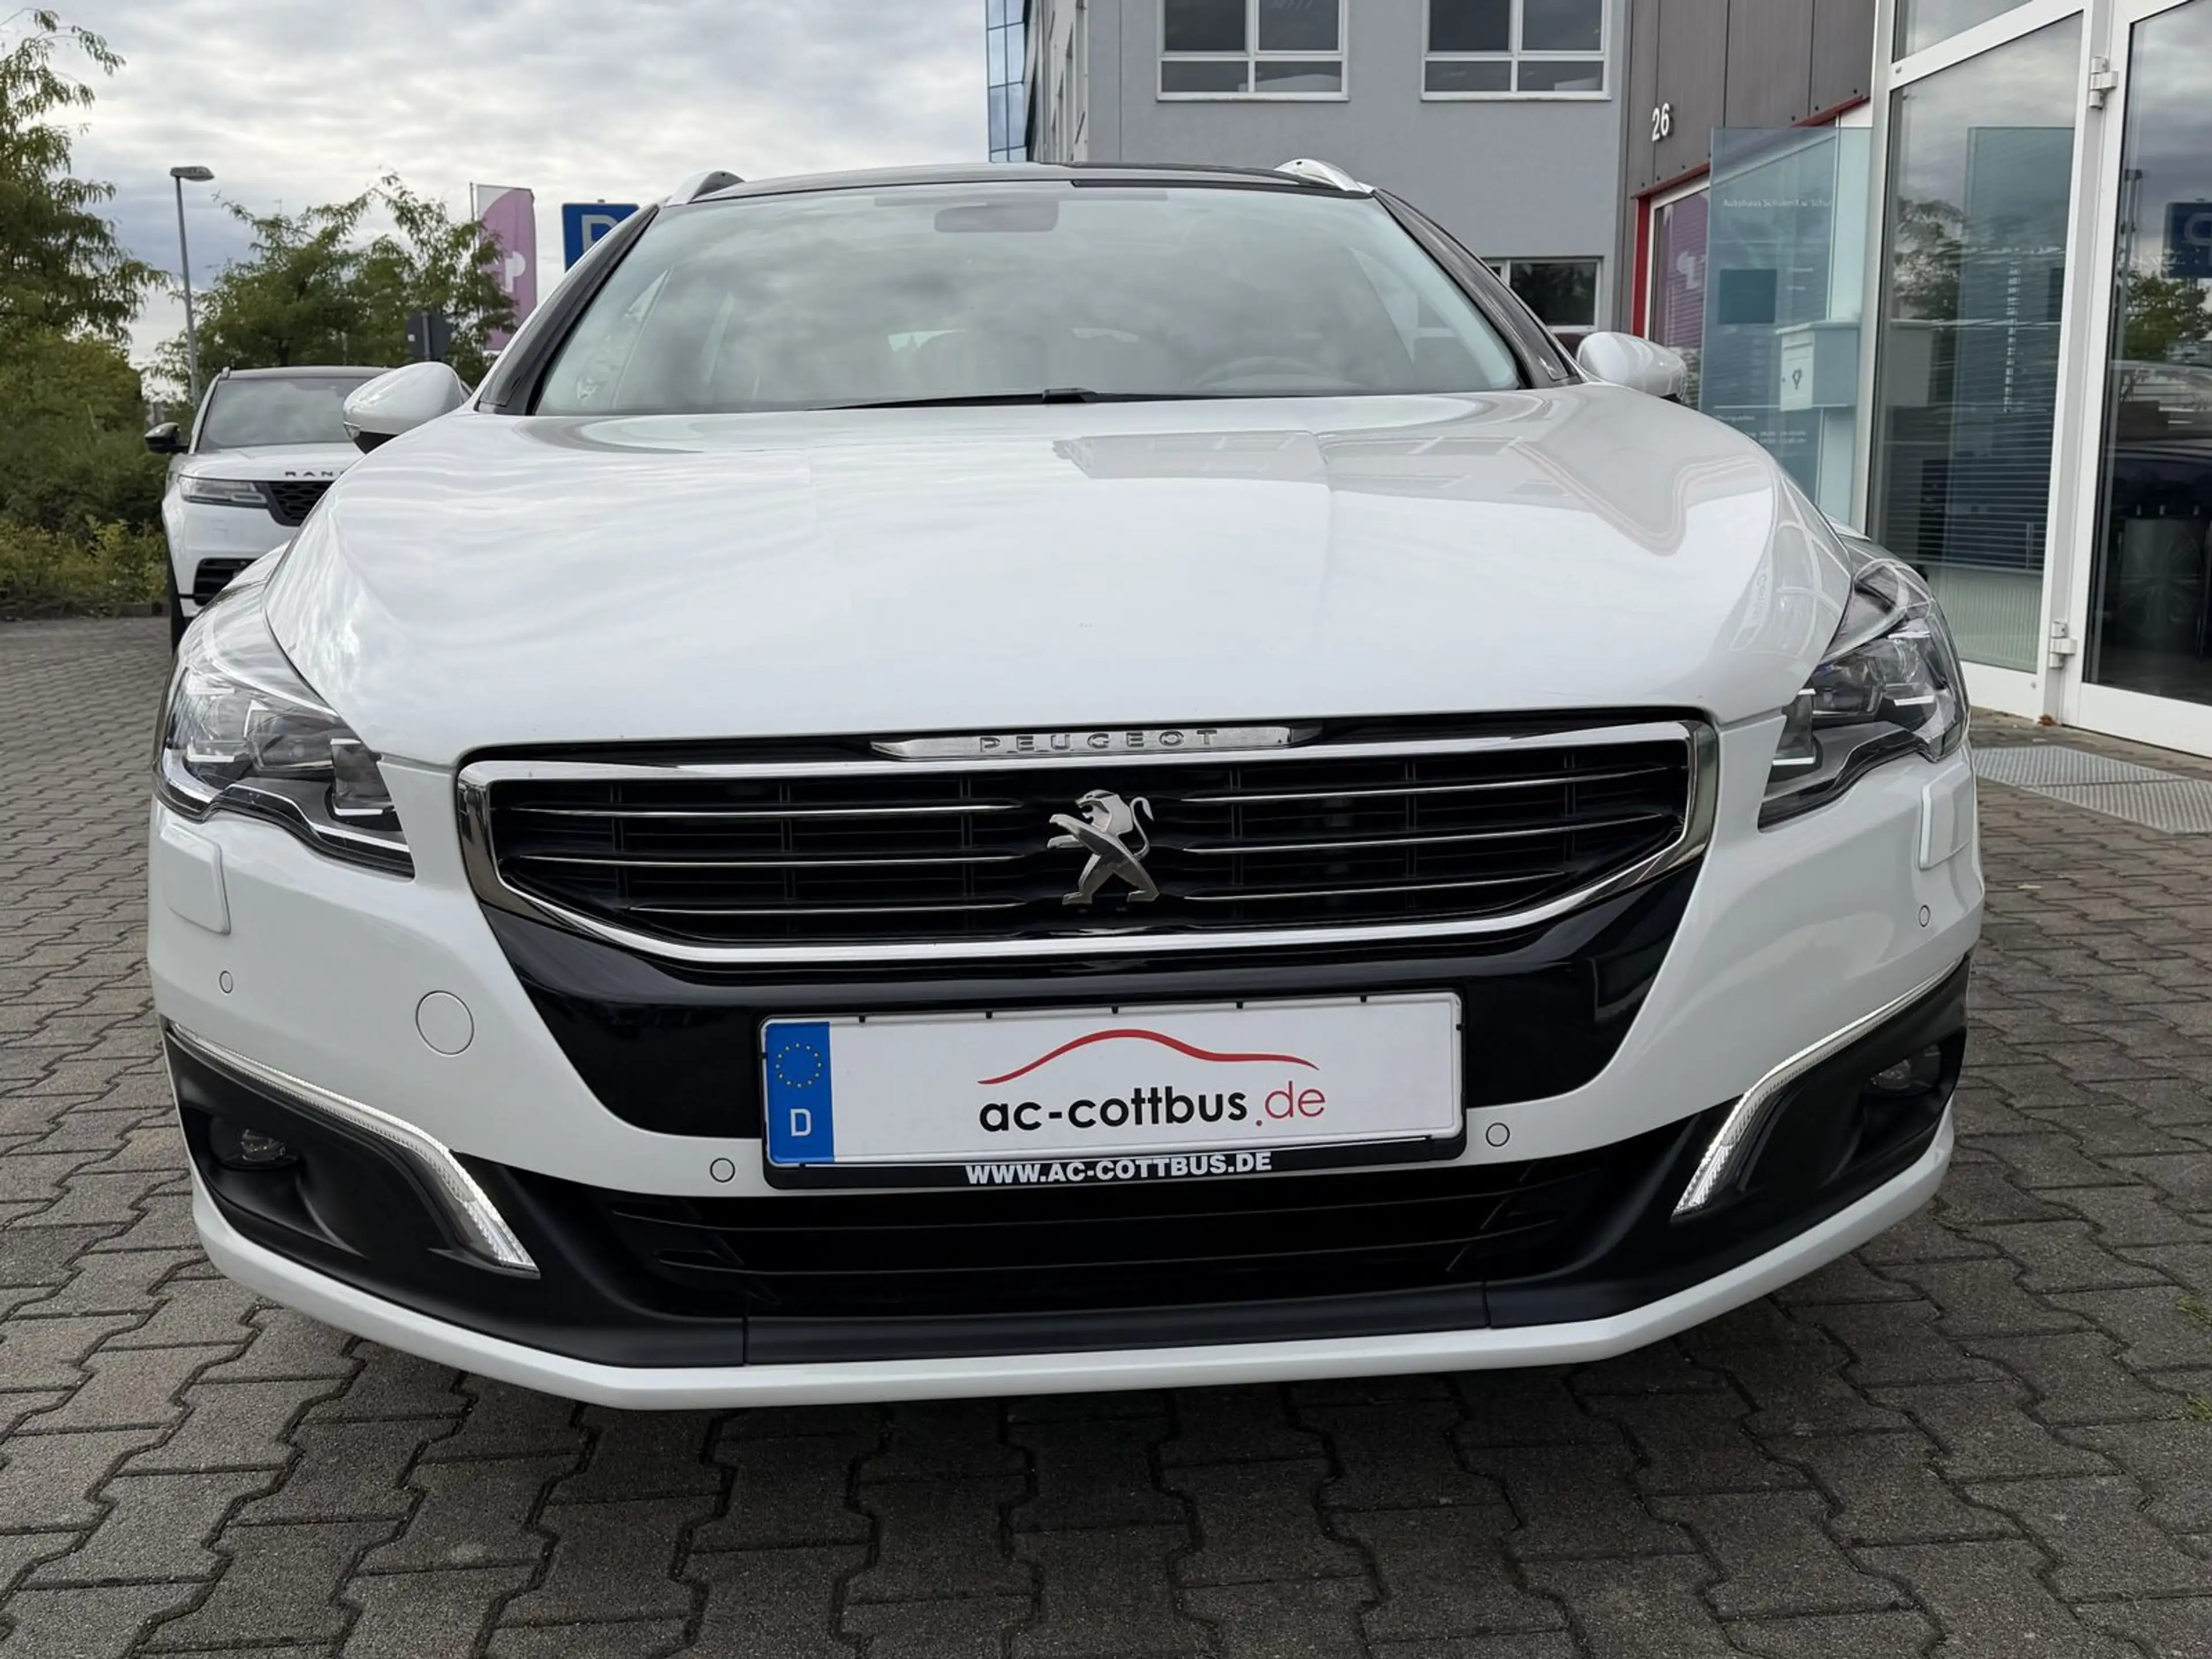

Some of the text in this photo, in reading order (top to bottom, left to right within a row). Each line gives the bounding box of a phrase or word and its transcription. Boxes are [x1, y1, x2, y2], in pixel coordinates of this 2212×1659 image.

[1652, 102, 1670, 142] 26
[980, 729, 1218, 753] PEUGEOT
[790, 1108, 811, 1137] D
[979, 1081, 1326, 1132] ac-cottbus.de
[965, 1152, 1272, 1185] WWW.AC-COTTBUS.DE
